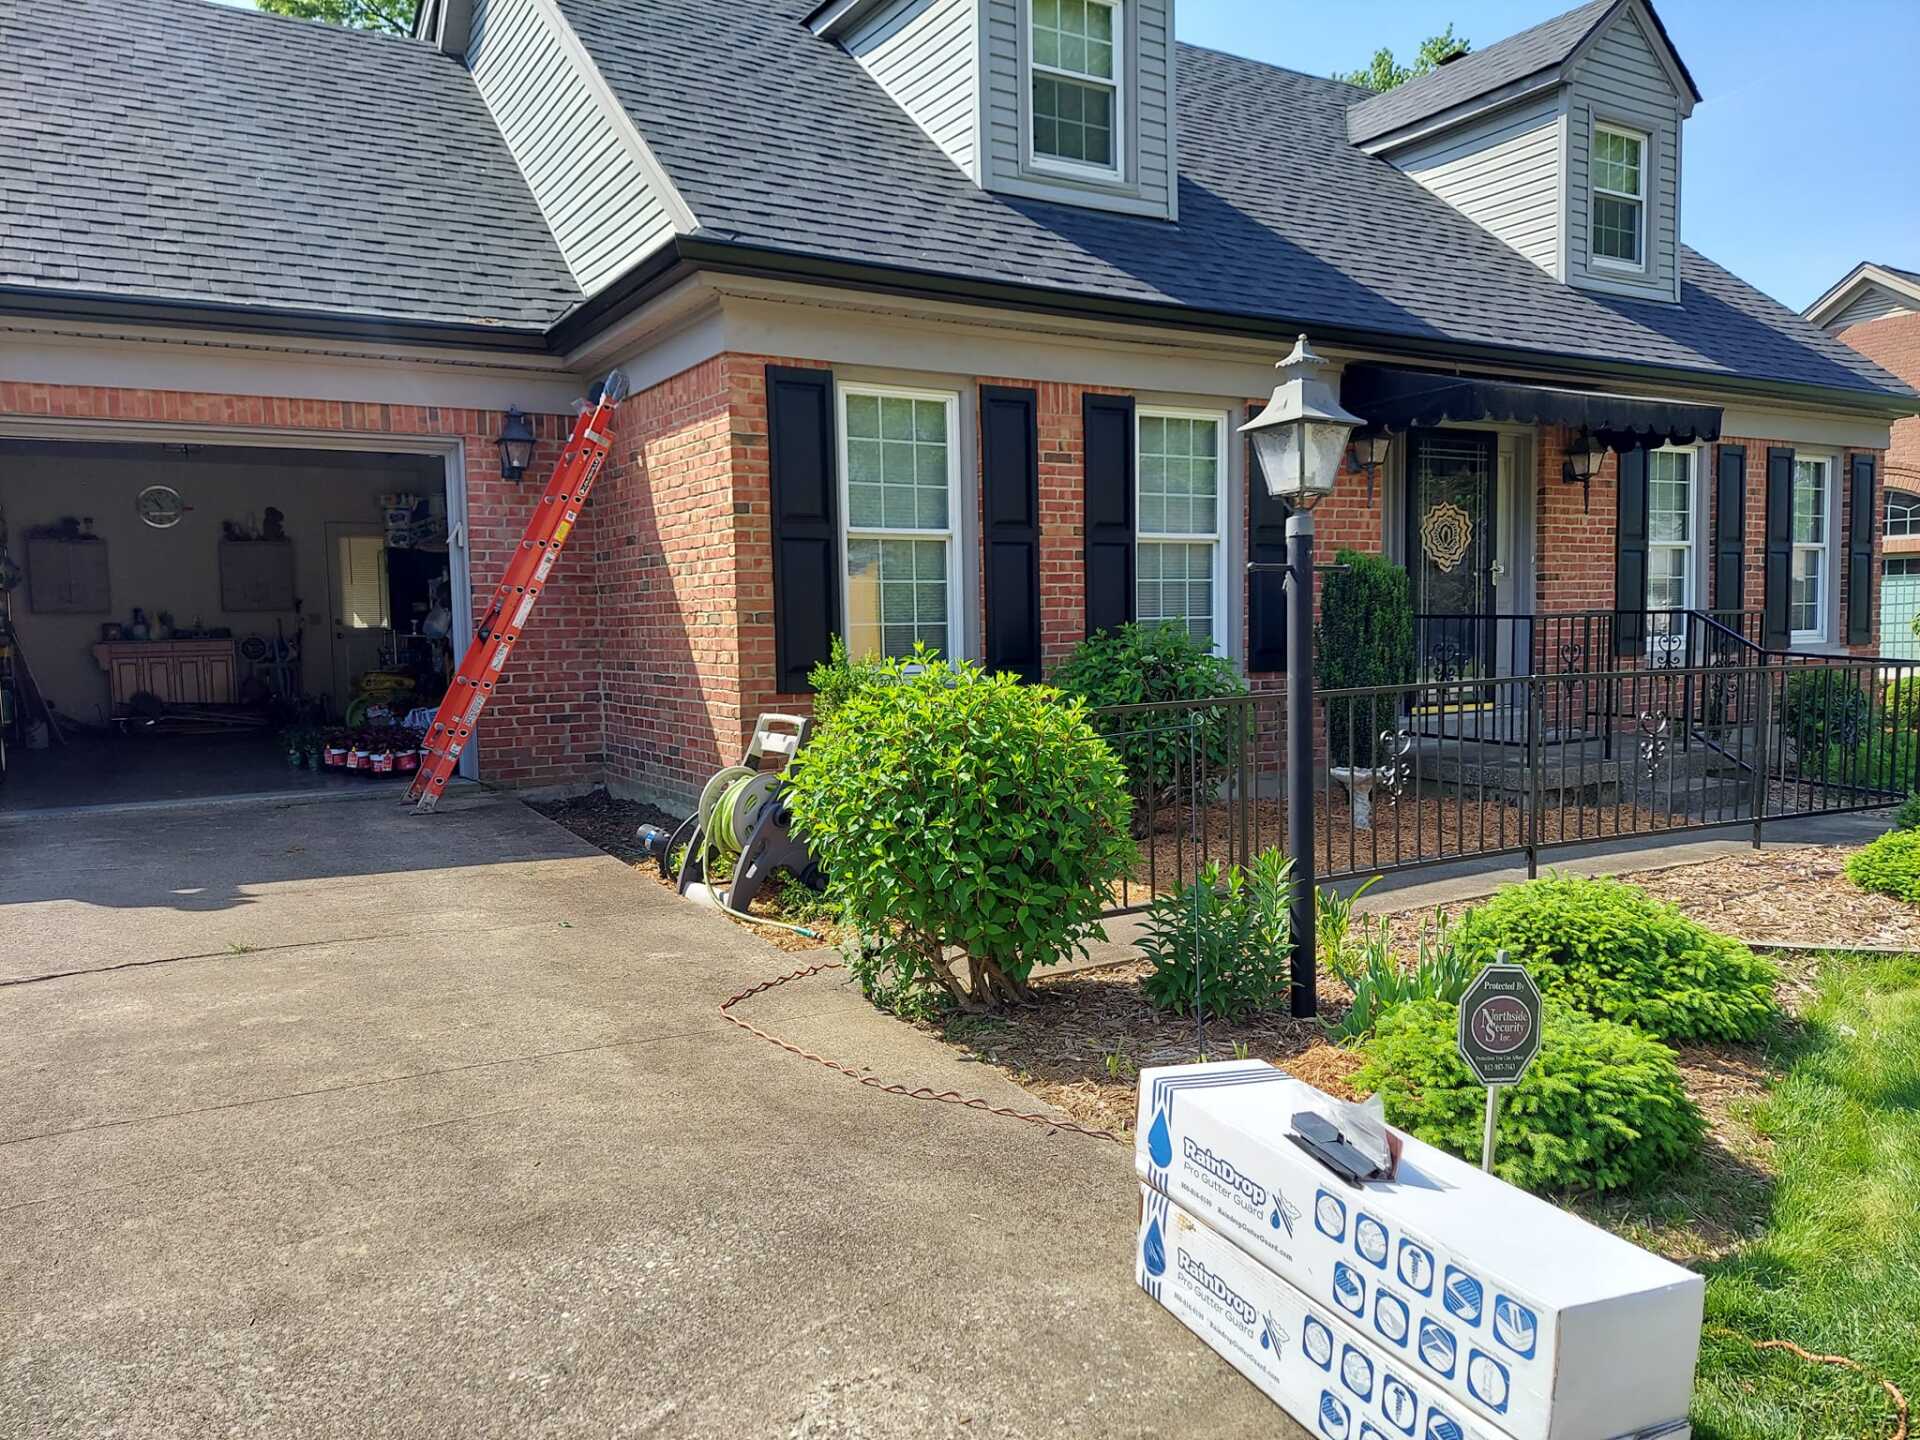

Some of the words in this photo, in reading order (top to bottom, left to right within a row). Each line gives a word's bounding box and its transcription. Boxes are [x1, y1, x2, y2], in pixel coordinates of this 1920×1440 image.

[1484, 981, 1515, 991] Protected
[1516, 981, 1525, 992] By
[1481, 1008, 1528, 1028] Northside
[1485, 1022, 1525, 1041] Security
[1184, 1136, 1267, 1206] RainDrop
[1184, 1162, 1200, 1180] Pro
[1200, 1172, 1232, 1200] Gutter
[1233, 1191, 1264, 1222] Guard
[1177, 1247, 1256, 1325] RainDrop
[1177, 1272, 1193, 1291] Pro
[1194, 1284, 1224, 1316] Gutter
[1225, 1309, 1254, 1341] Guard
